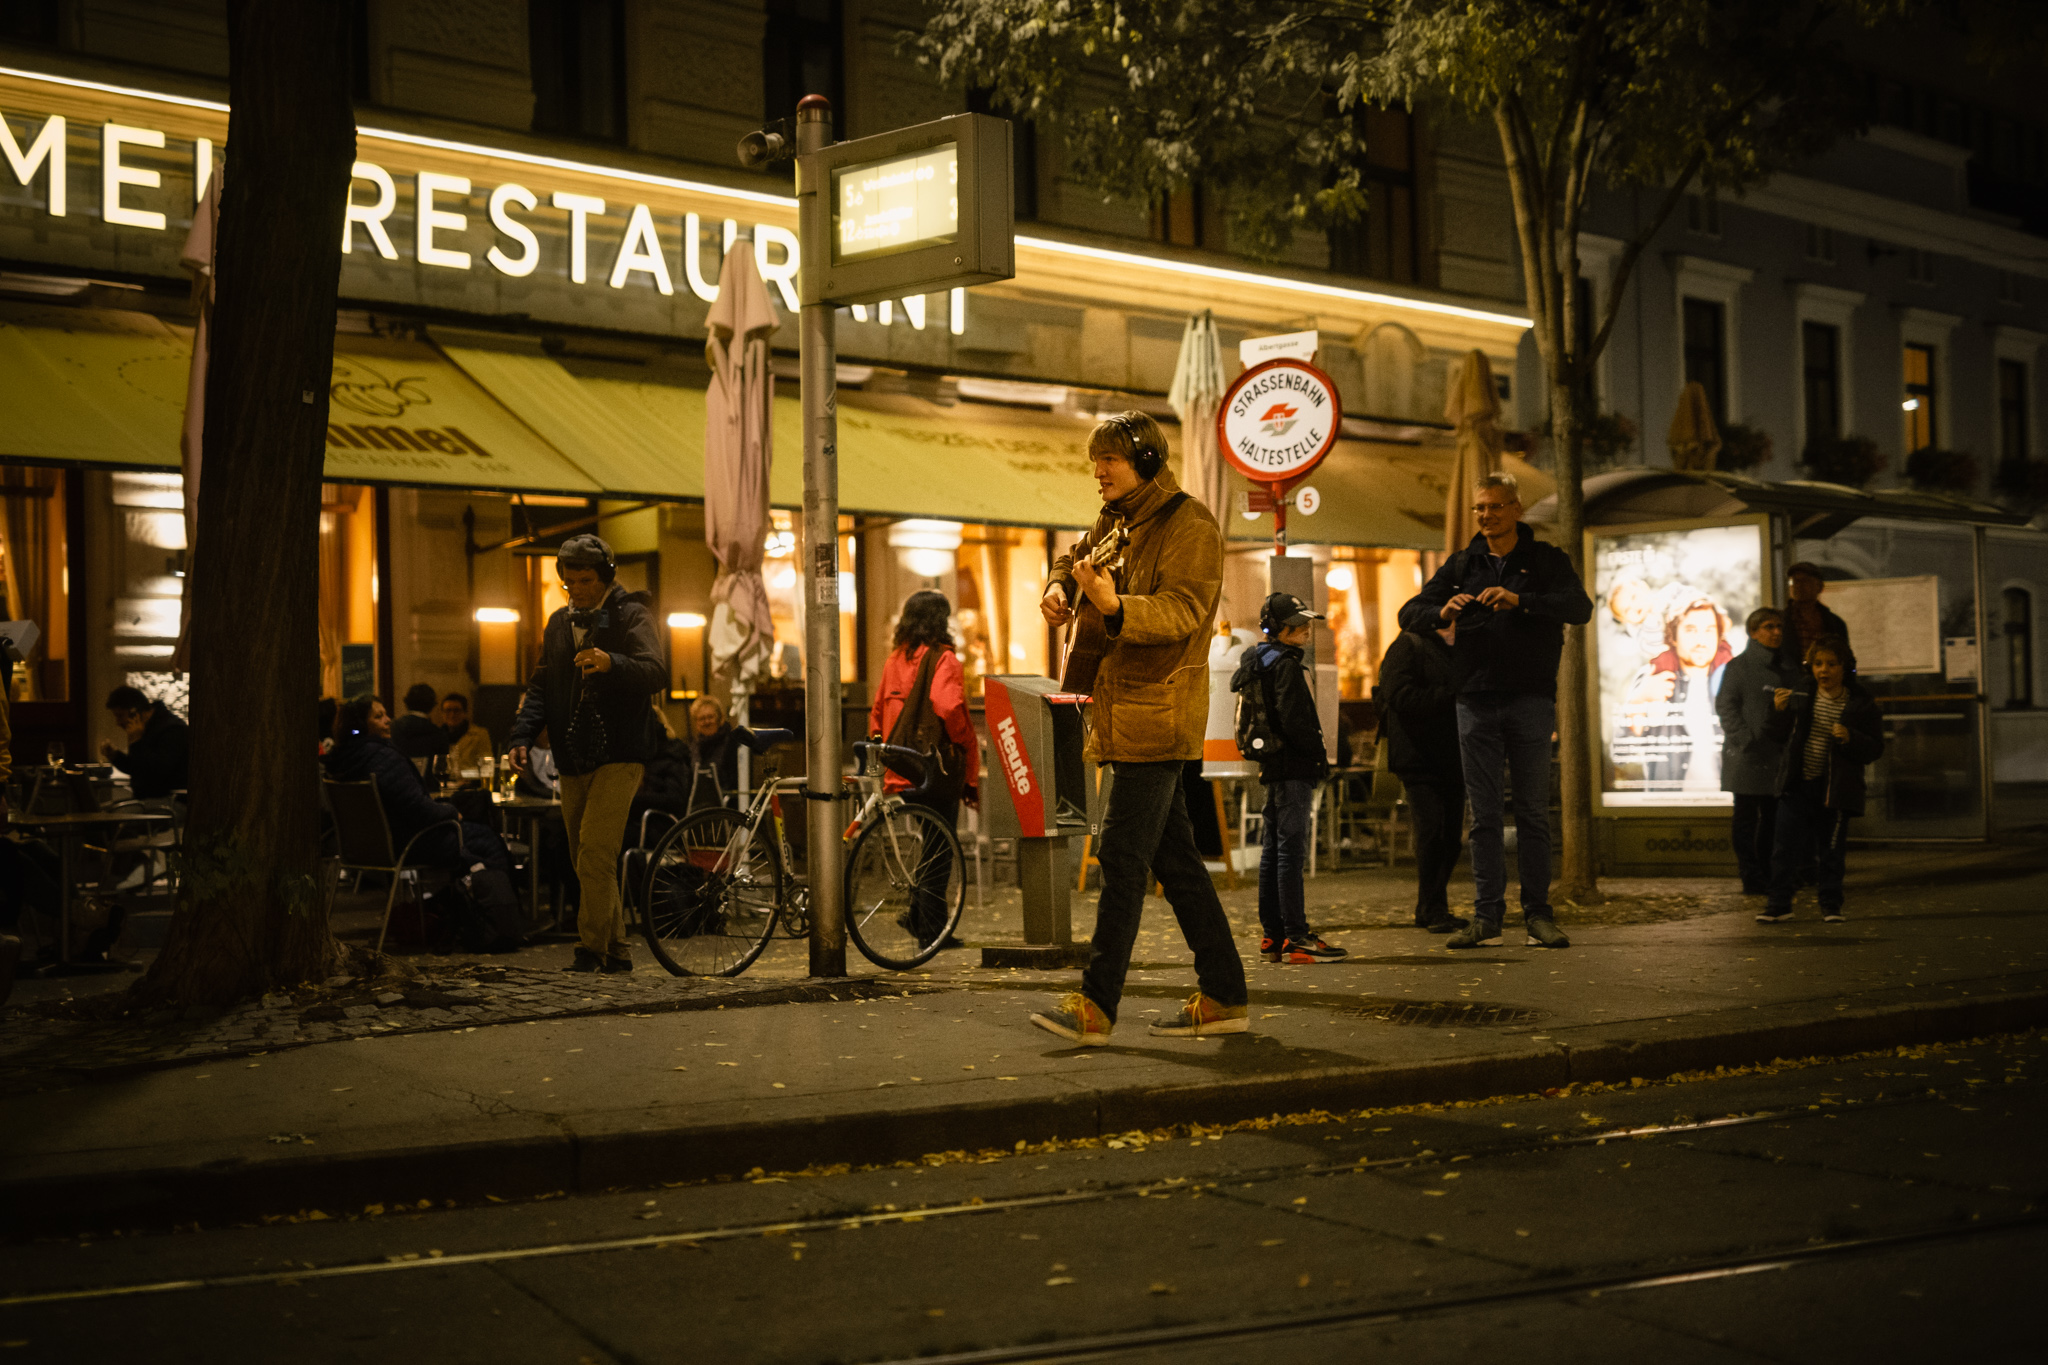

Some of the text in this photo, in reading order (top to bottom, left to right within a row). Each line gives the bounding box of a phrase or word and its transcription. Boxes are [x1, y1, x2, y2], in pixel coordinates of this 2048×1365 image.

[342, 161, 967, 335] RESTAUR
[840, 219, 856, 244] 12
[1258, 340, 1299, 351] Albertgasse
[1234, 373, 1326, 417] STRASSENBAHN
[327, 424, 492, 458] mmel
[1239, 427, 1323, 465] HALTESTELLE
[1303, 492, 1314, 509] 5
[997, 716, 1032, 796] Heute
